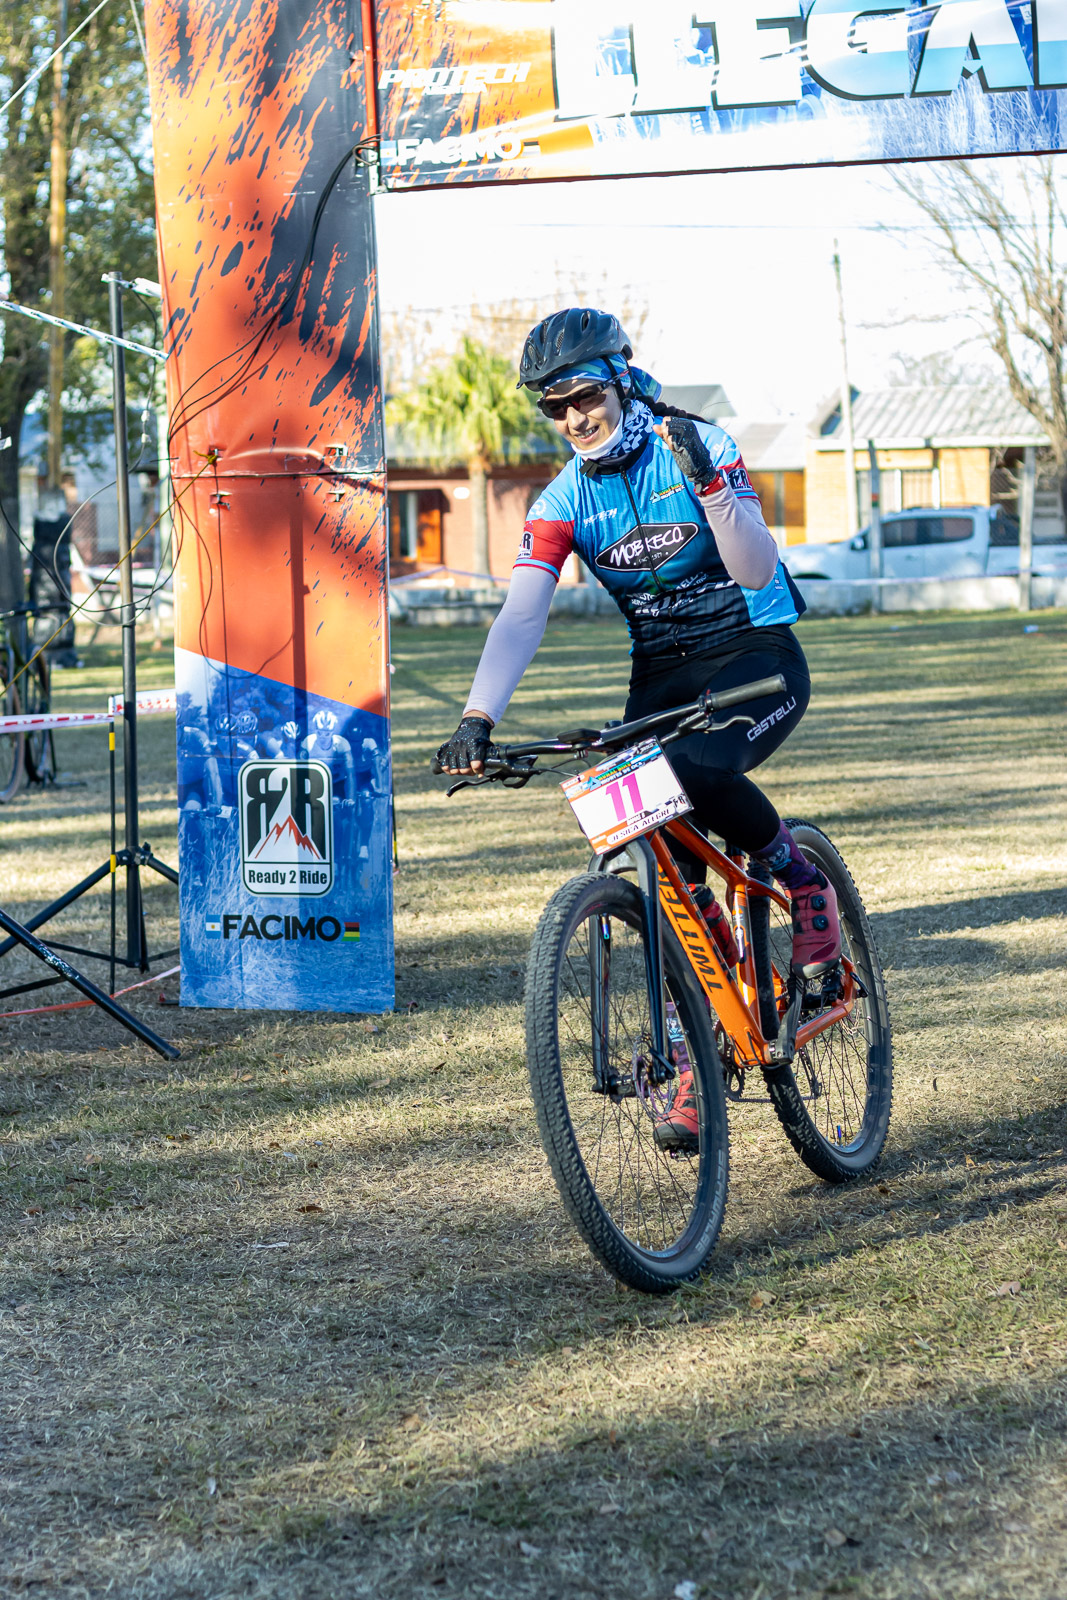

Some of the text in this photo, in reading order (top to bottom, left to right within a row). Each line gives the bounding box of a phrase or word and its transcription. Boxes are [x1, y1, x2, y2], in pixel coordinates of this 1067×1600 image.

[377, 62, 532, 90] PROTECH
[606, 773, 644, 822] 11
[248, 870, 328, 885] Ready 2 Ride
[223, 914, 342, 942] FACIMO
